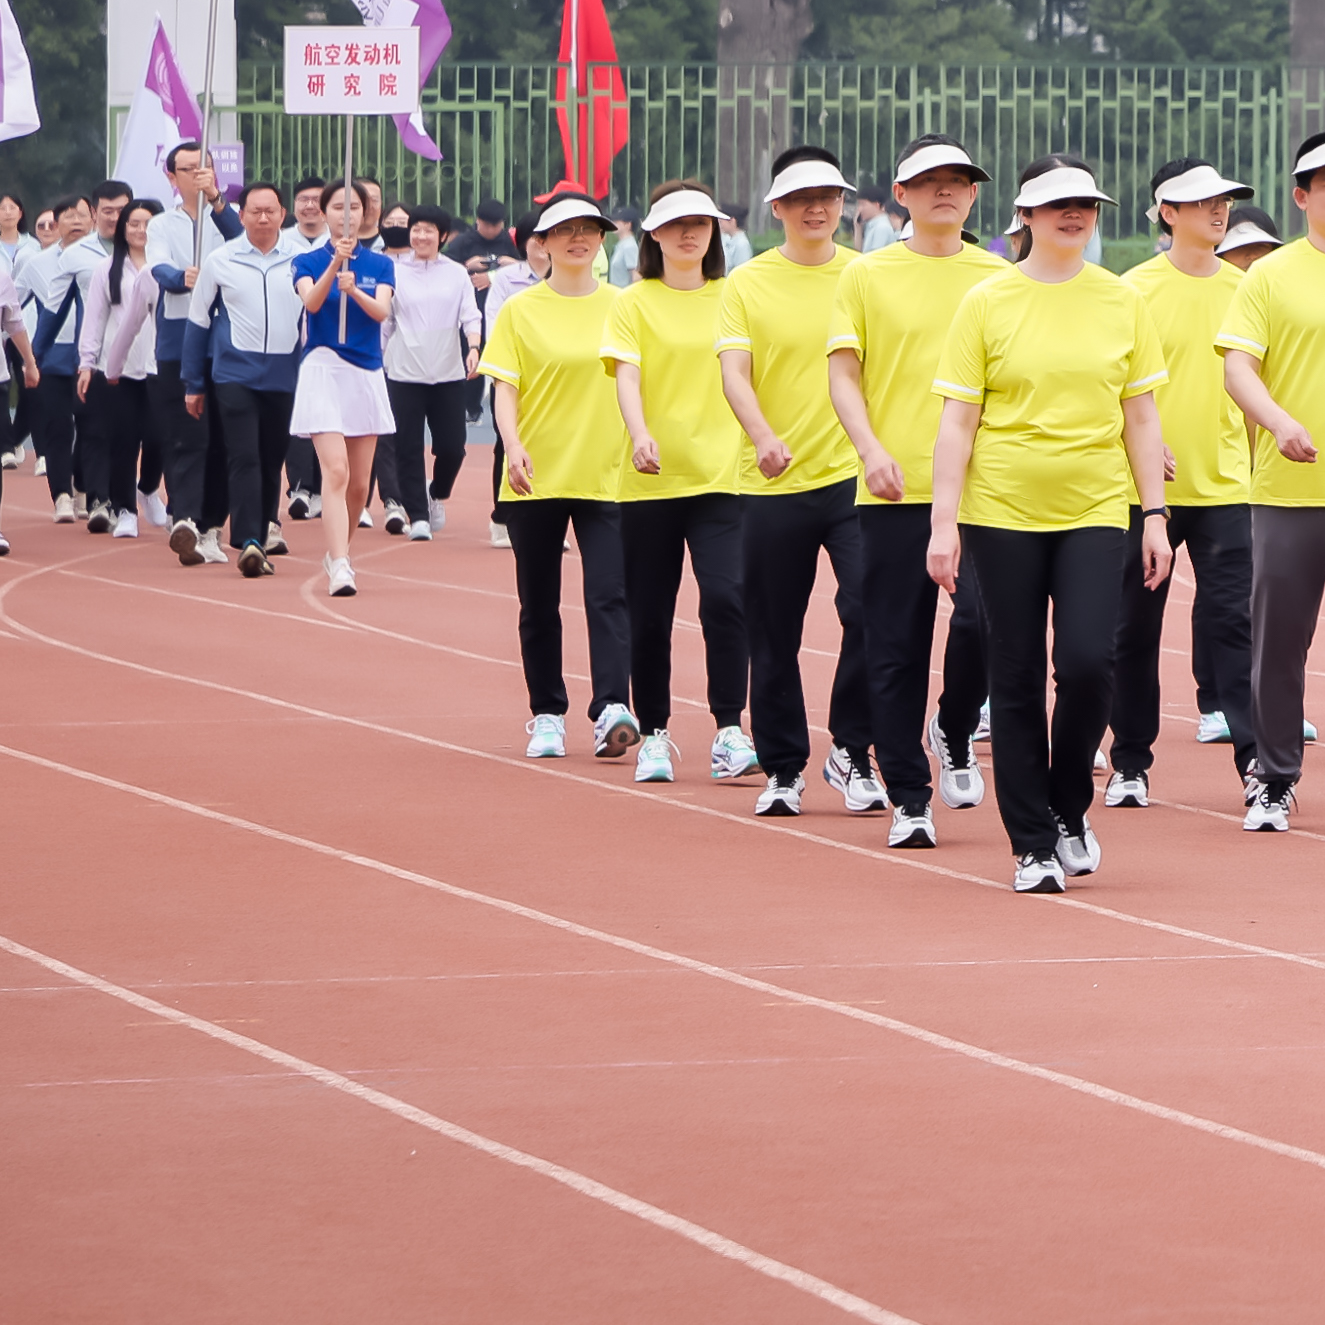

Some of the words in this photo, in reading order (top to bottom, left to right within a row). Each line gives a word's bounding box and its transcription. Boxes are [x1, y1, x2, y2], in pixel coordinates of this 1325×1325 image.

[304, 43, 401, 66] 航空发动机
[307, 73, 397, 96] 研究院
